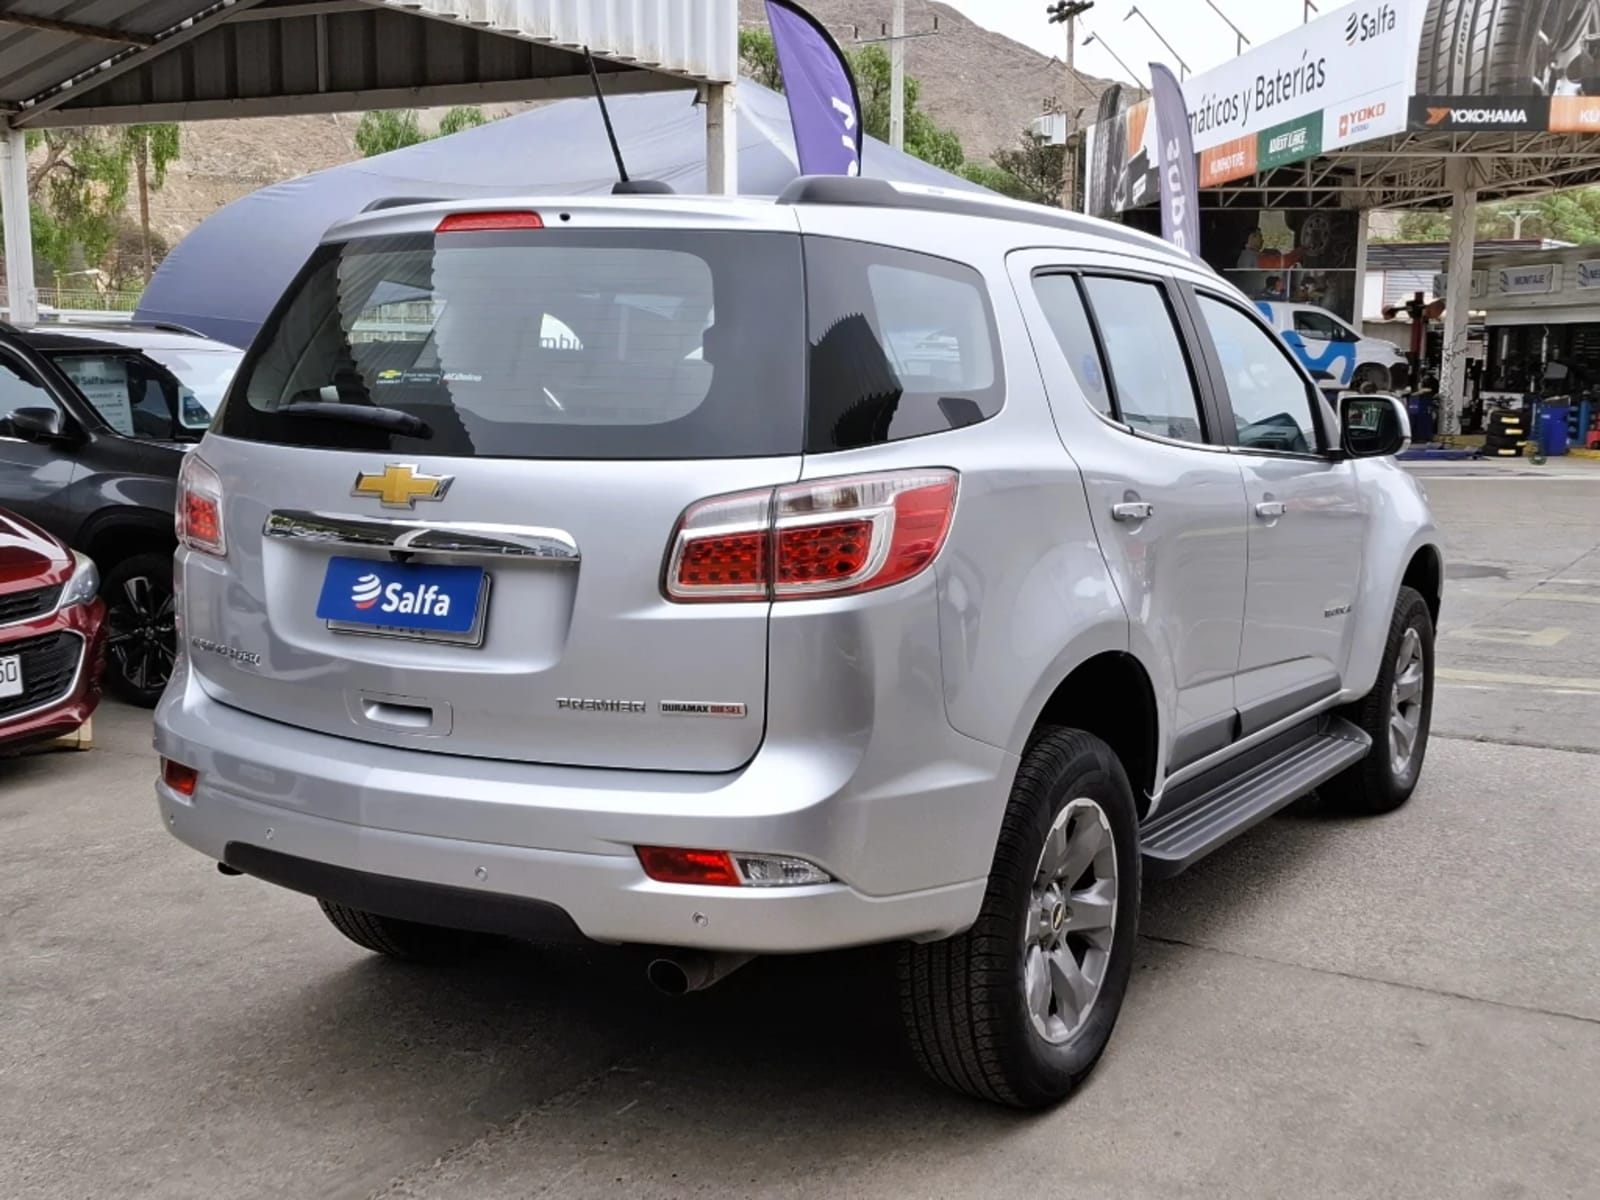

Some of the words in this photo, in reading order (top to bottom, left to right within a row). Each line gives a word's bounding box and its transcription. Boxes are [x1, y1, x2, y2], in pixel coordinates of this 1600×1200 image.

[1360, 4, 1396, 42] Salfa
[1242, 87, 1253, 127] y
[1255, 49, 1326, 112] Baterías
[1350, 102, 1386, 124] YOKO
[1450, 109, 1528, 123] YOKOHAMA
[381, 582, 450, 617] Salfa
[556, 697, 646, 713] PREMIER
[661, 703, 709, 714] DURAMAX
[710, 705, 744, 715] DIESEL
